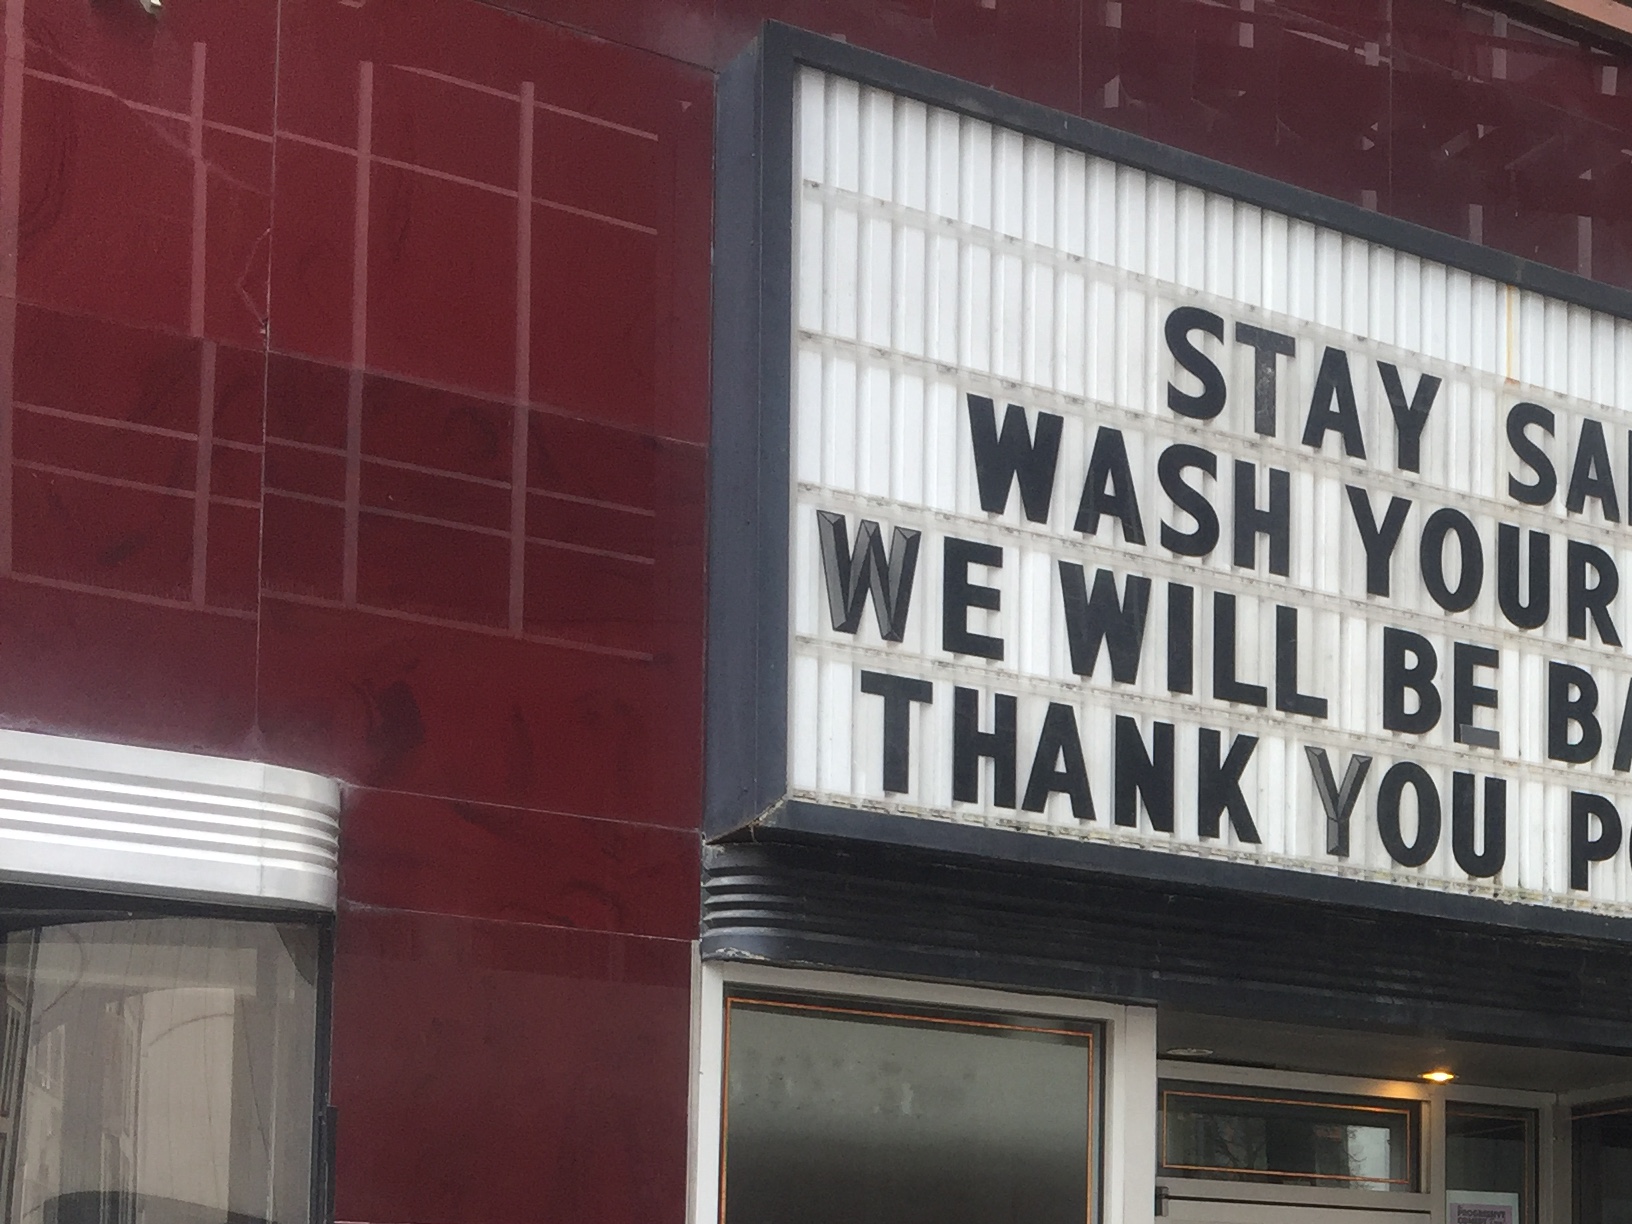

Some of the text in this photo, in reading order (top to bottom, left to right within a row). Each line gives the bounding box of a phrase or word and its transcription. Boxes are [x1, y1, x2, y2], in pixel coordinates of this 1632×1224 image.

[1164, 306, 1442, 474] STAY
[816, 509, 1005, 662] WE
[1057, 559, 1328, 720] WILL
[1382, 625, 1501, 750] BE
[966, 392, 1290, 578] WASH
[1345, 484, 1623, 648] YOUR
[860, 669, 1262, 845] THANK
[1304, 744, 1507, 879] YOU
